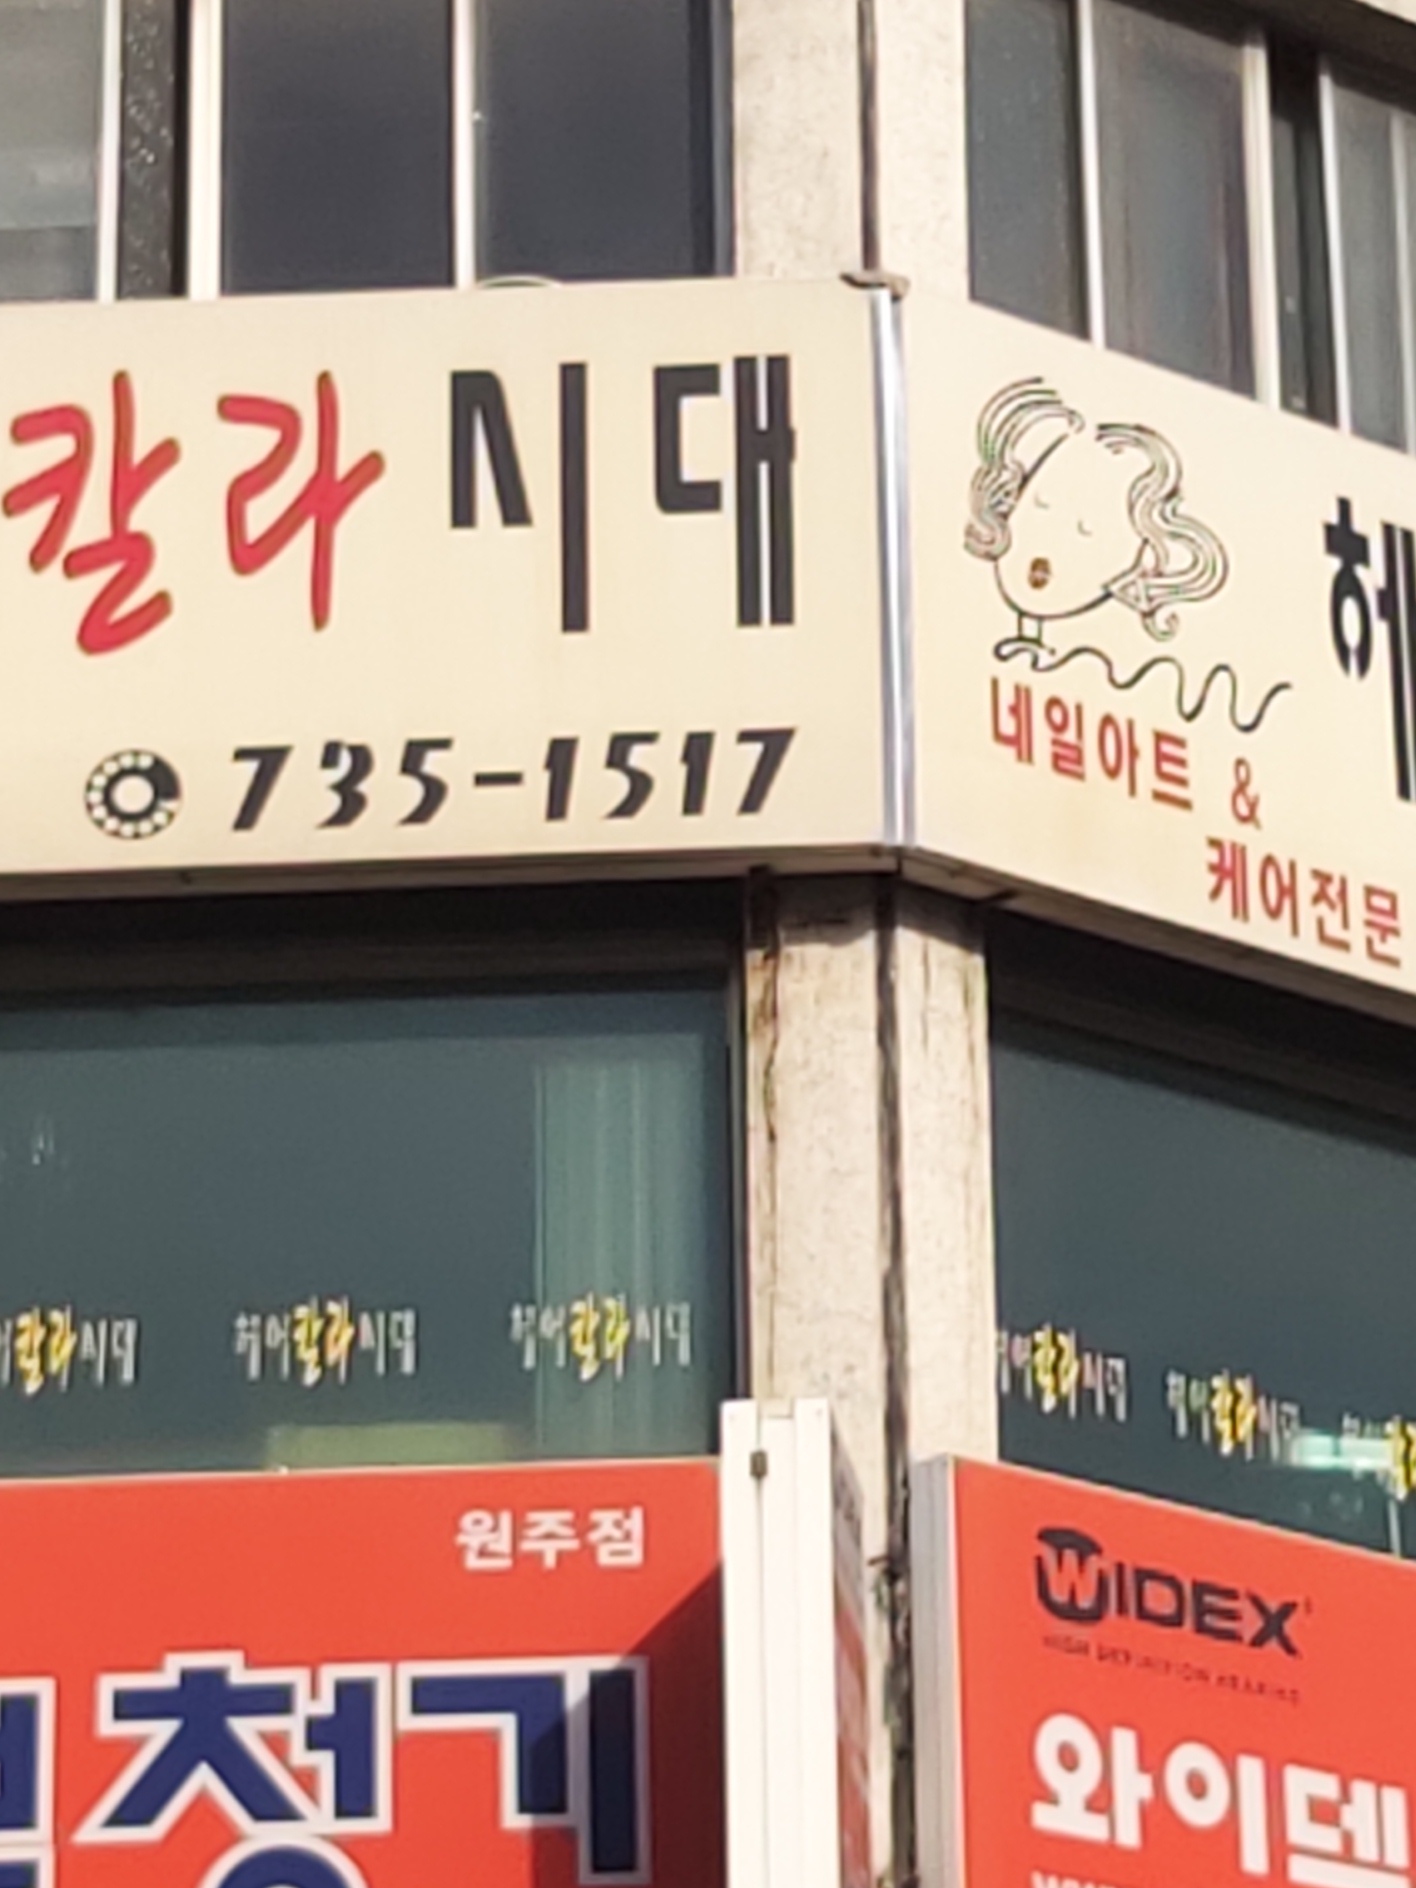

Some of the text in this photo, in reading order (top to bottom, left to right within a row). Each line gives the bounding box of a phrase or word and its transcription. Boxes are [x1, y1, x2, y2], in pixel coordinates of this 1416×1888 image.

[232, 728, 796, 831] 735-1517
[991, 676, 1262, 830] 네일아트 &
[1206, 836, 1402, 969] 케어전문
[455, 1506, 647, 1572] 원주점
[1034, 1527, 1301, 1659] WIDEX
